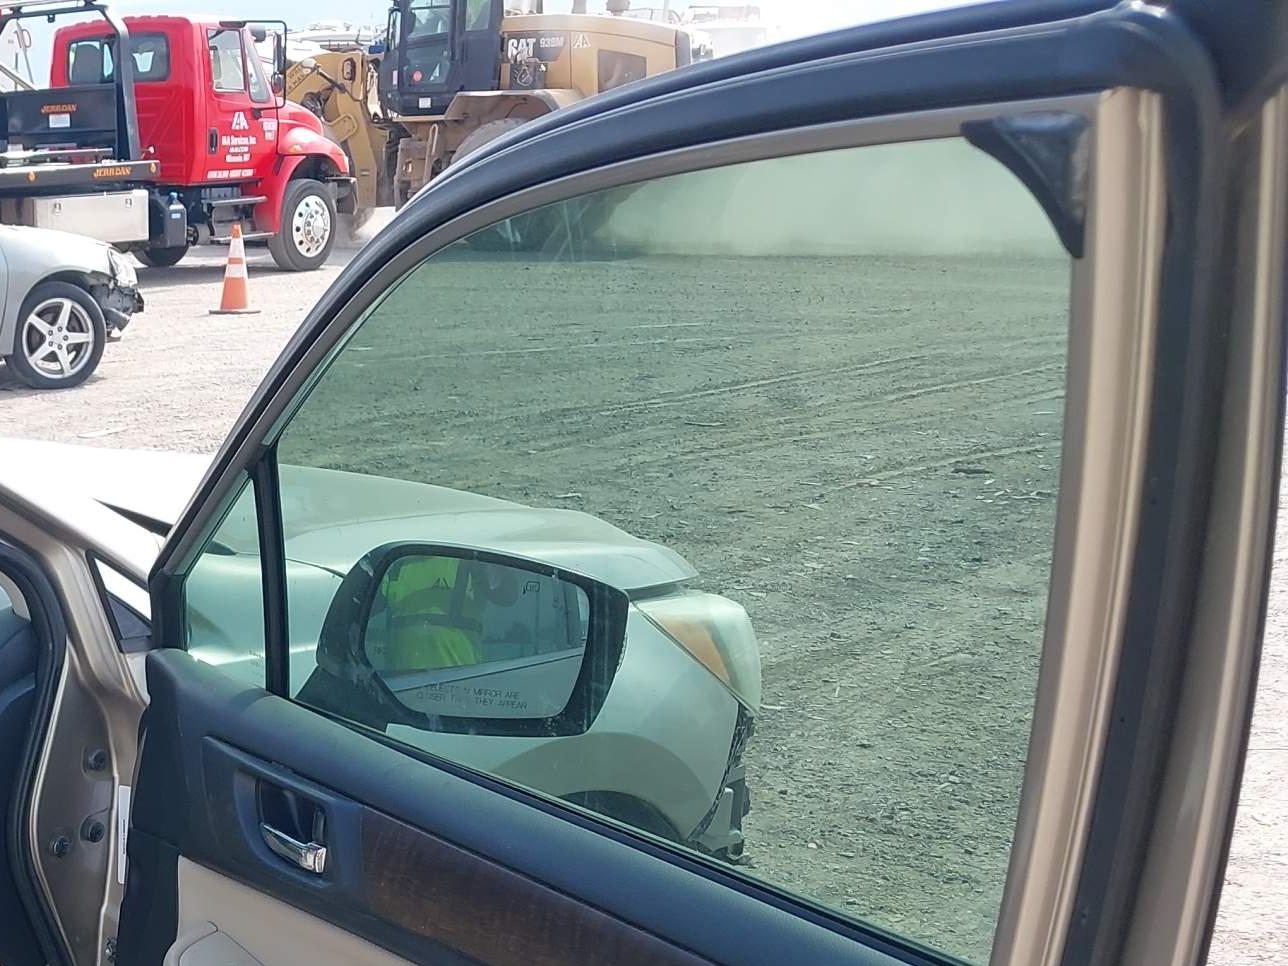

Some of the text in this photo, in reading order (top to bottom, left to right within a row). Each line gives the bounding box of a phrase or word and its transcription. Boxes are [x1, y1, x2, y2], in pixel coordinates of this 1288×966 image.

[507, 38, 536, 61] CAT
[473, 687, 502, 697] MIRROR
[504, 689, 521, 699] ARE
